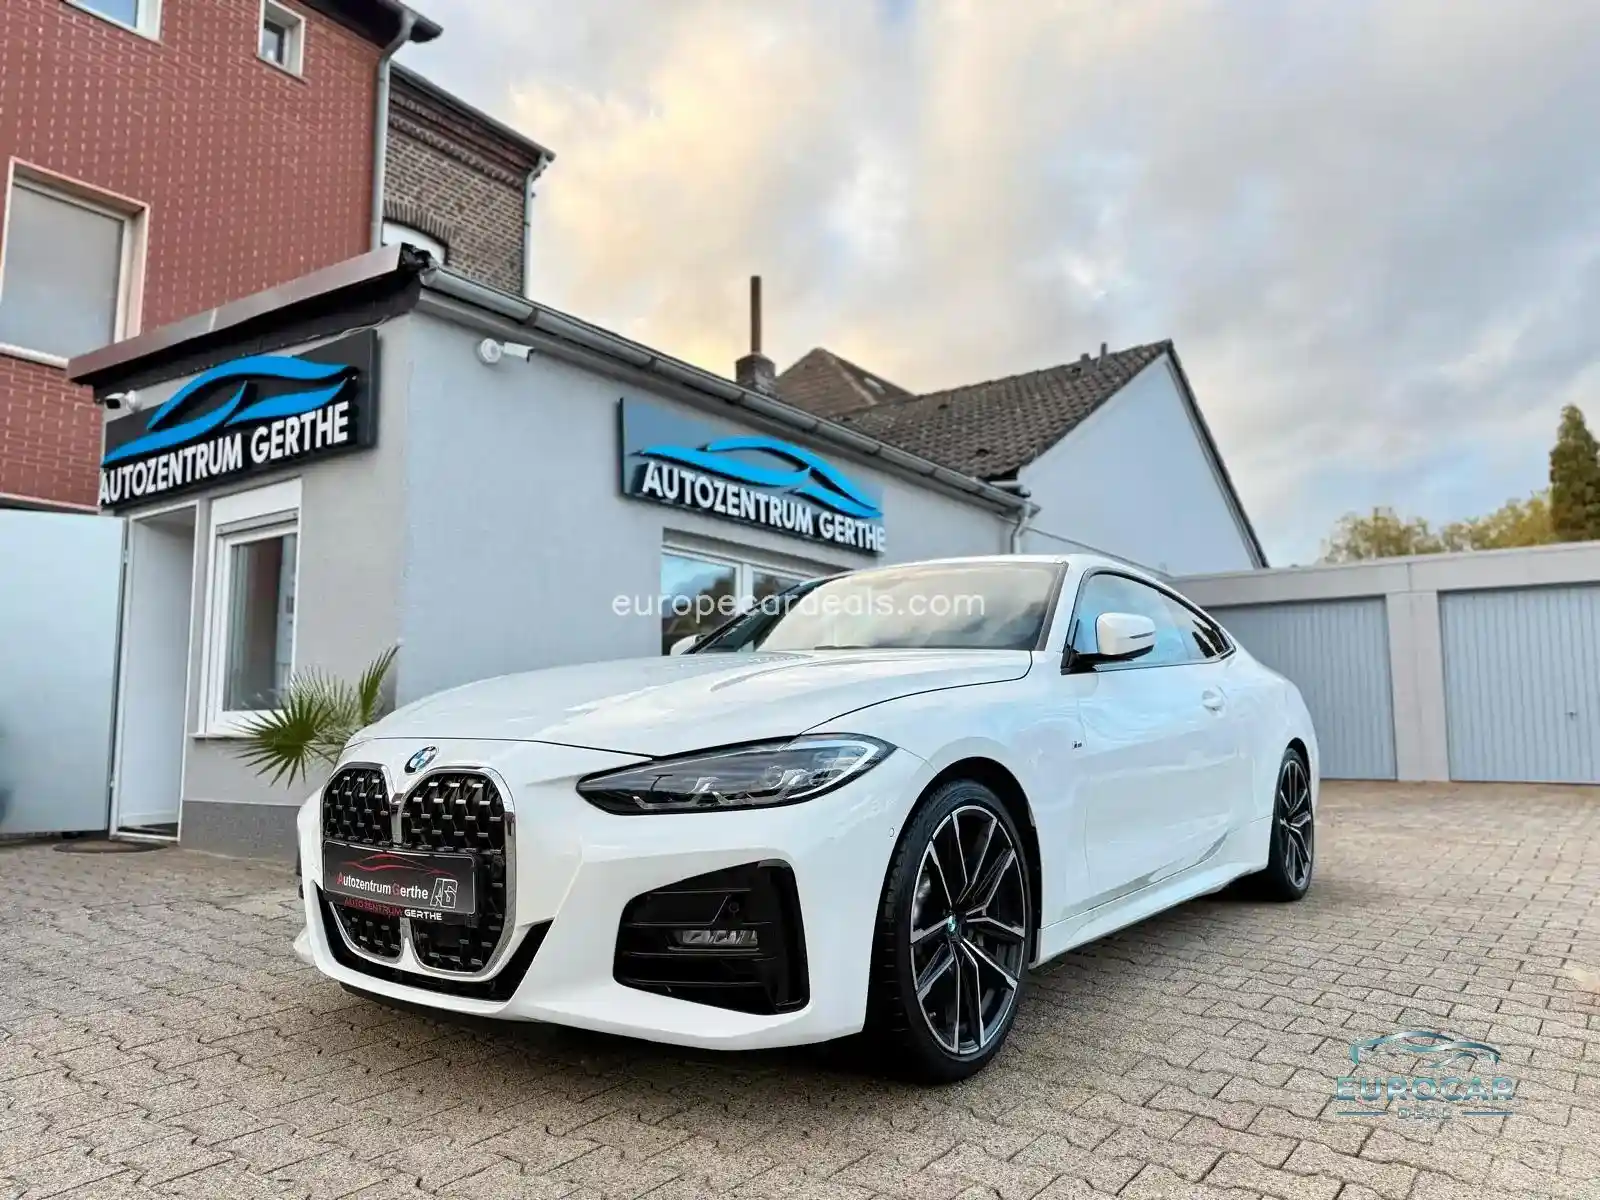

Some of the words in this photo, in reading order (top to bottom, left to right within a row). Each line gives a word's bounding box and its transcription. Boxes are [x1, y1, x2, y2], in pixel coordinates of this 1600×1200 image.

[98, 433, 243, 505] AUTOZENTRUM
[250, 401, 349, 464] GERTHE
[642, 461, 814, 535] AUTOZENTRUM
[818, 511, 886, 552] GERTHE
[404, 908, 443, 921] GERTHE
